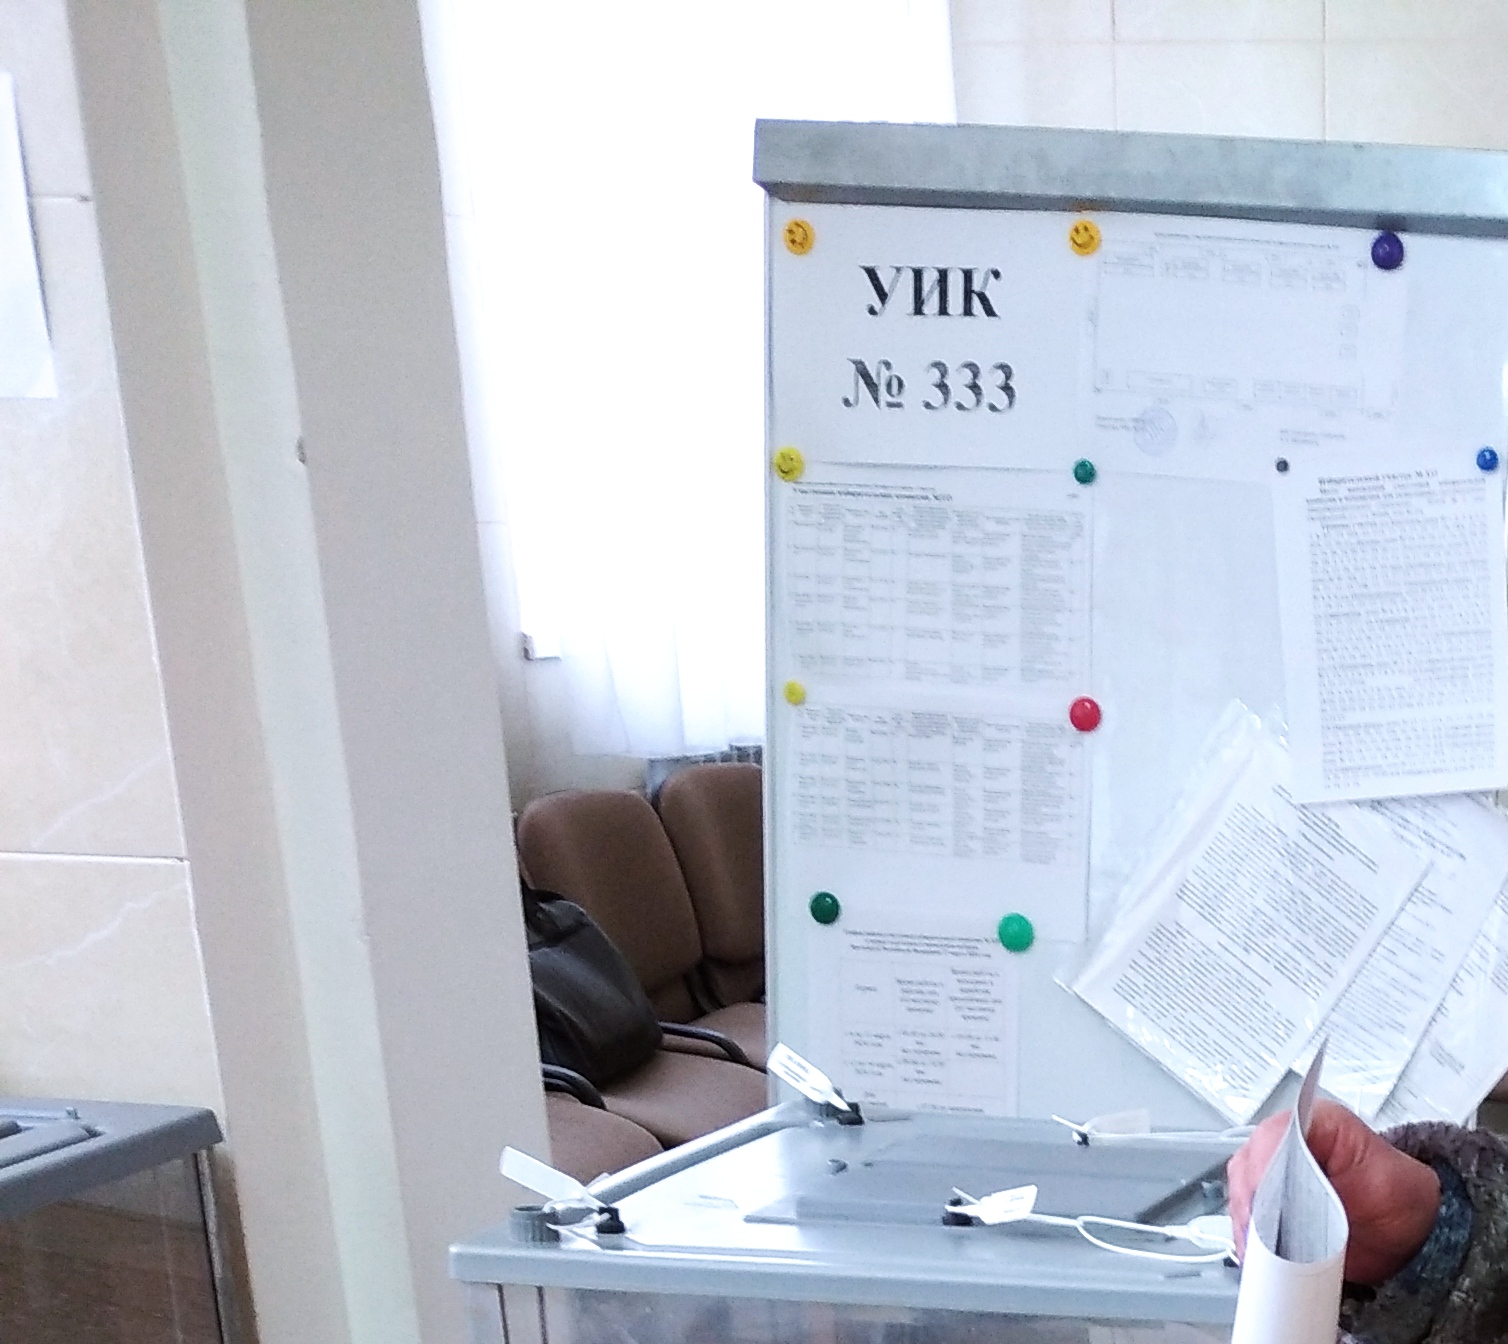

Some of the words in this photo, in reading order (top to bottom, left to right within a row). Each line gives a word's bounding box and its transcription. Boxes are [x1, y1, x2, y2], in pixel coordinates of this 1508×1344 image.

[858, 265, 1002, 318] УИК
[841, 358, 906, 410] №
[921, 360, 1016, 412] 333
